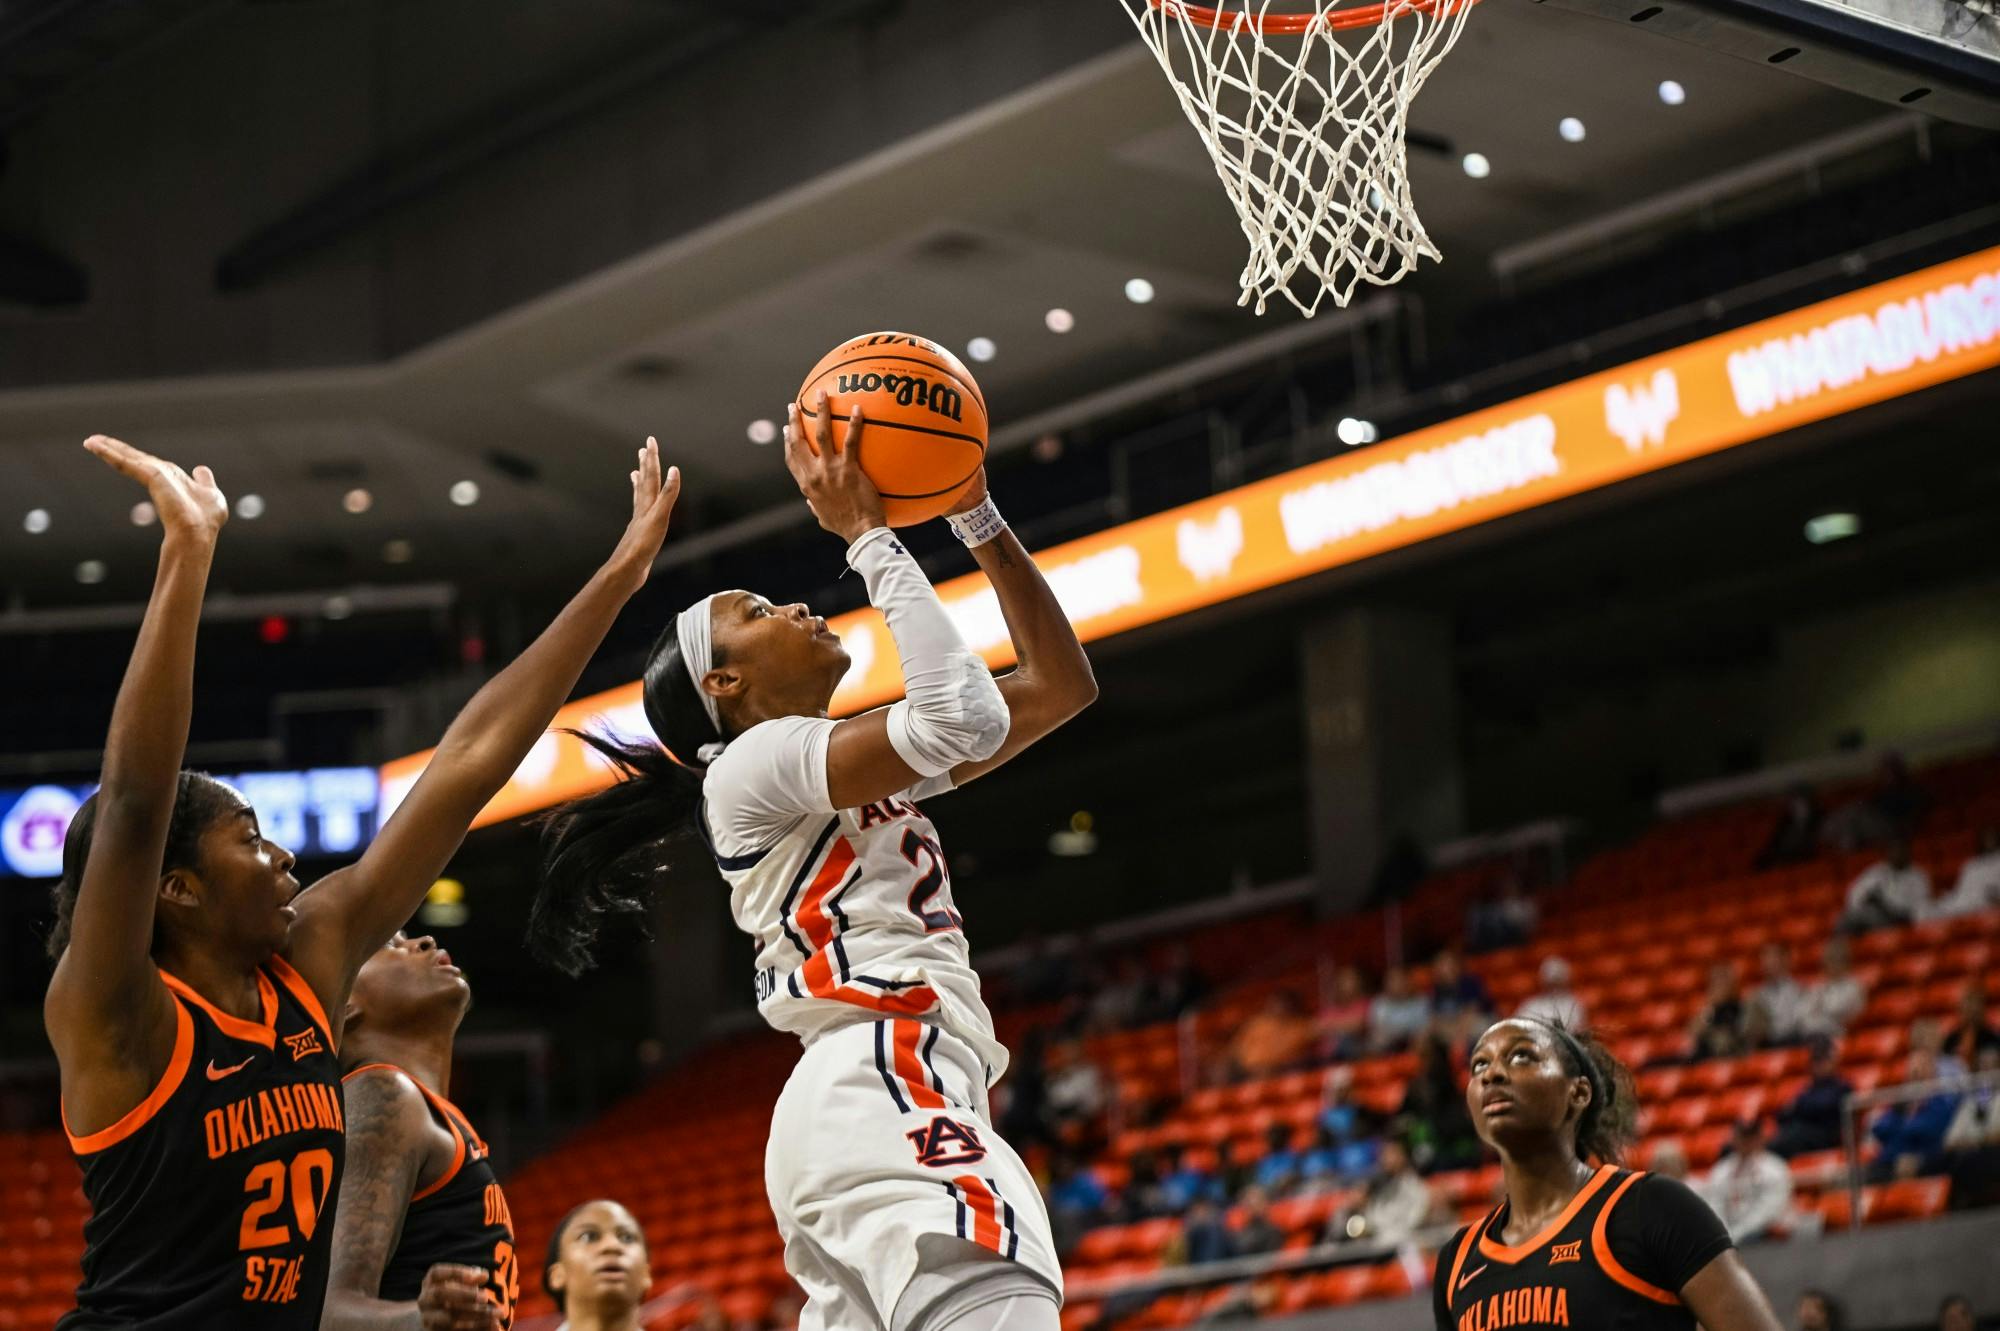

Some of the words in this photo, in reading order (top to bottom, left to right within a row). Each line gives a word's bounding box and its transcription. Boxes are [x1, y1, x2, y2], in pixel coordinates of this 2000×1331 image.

[838, 373, 962, 423] Wilson
[204, 1083, 344, 1160] OKLAHOMA
[238, 1148, 333, 1251] 20
